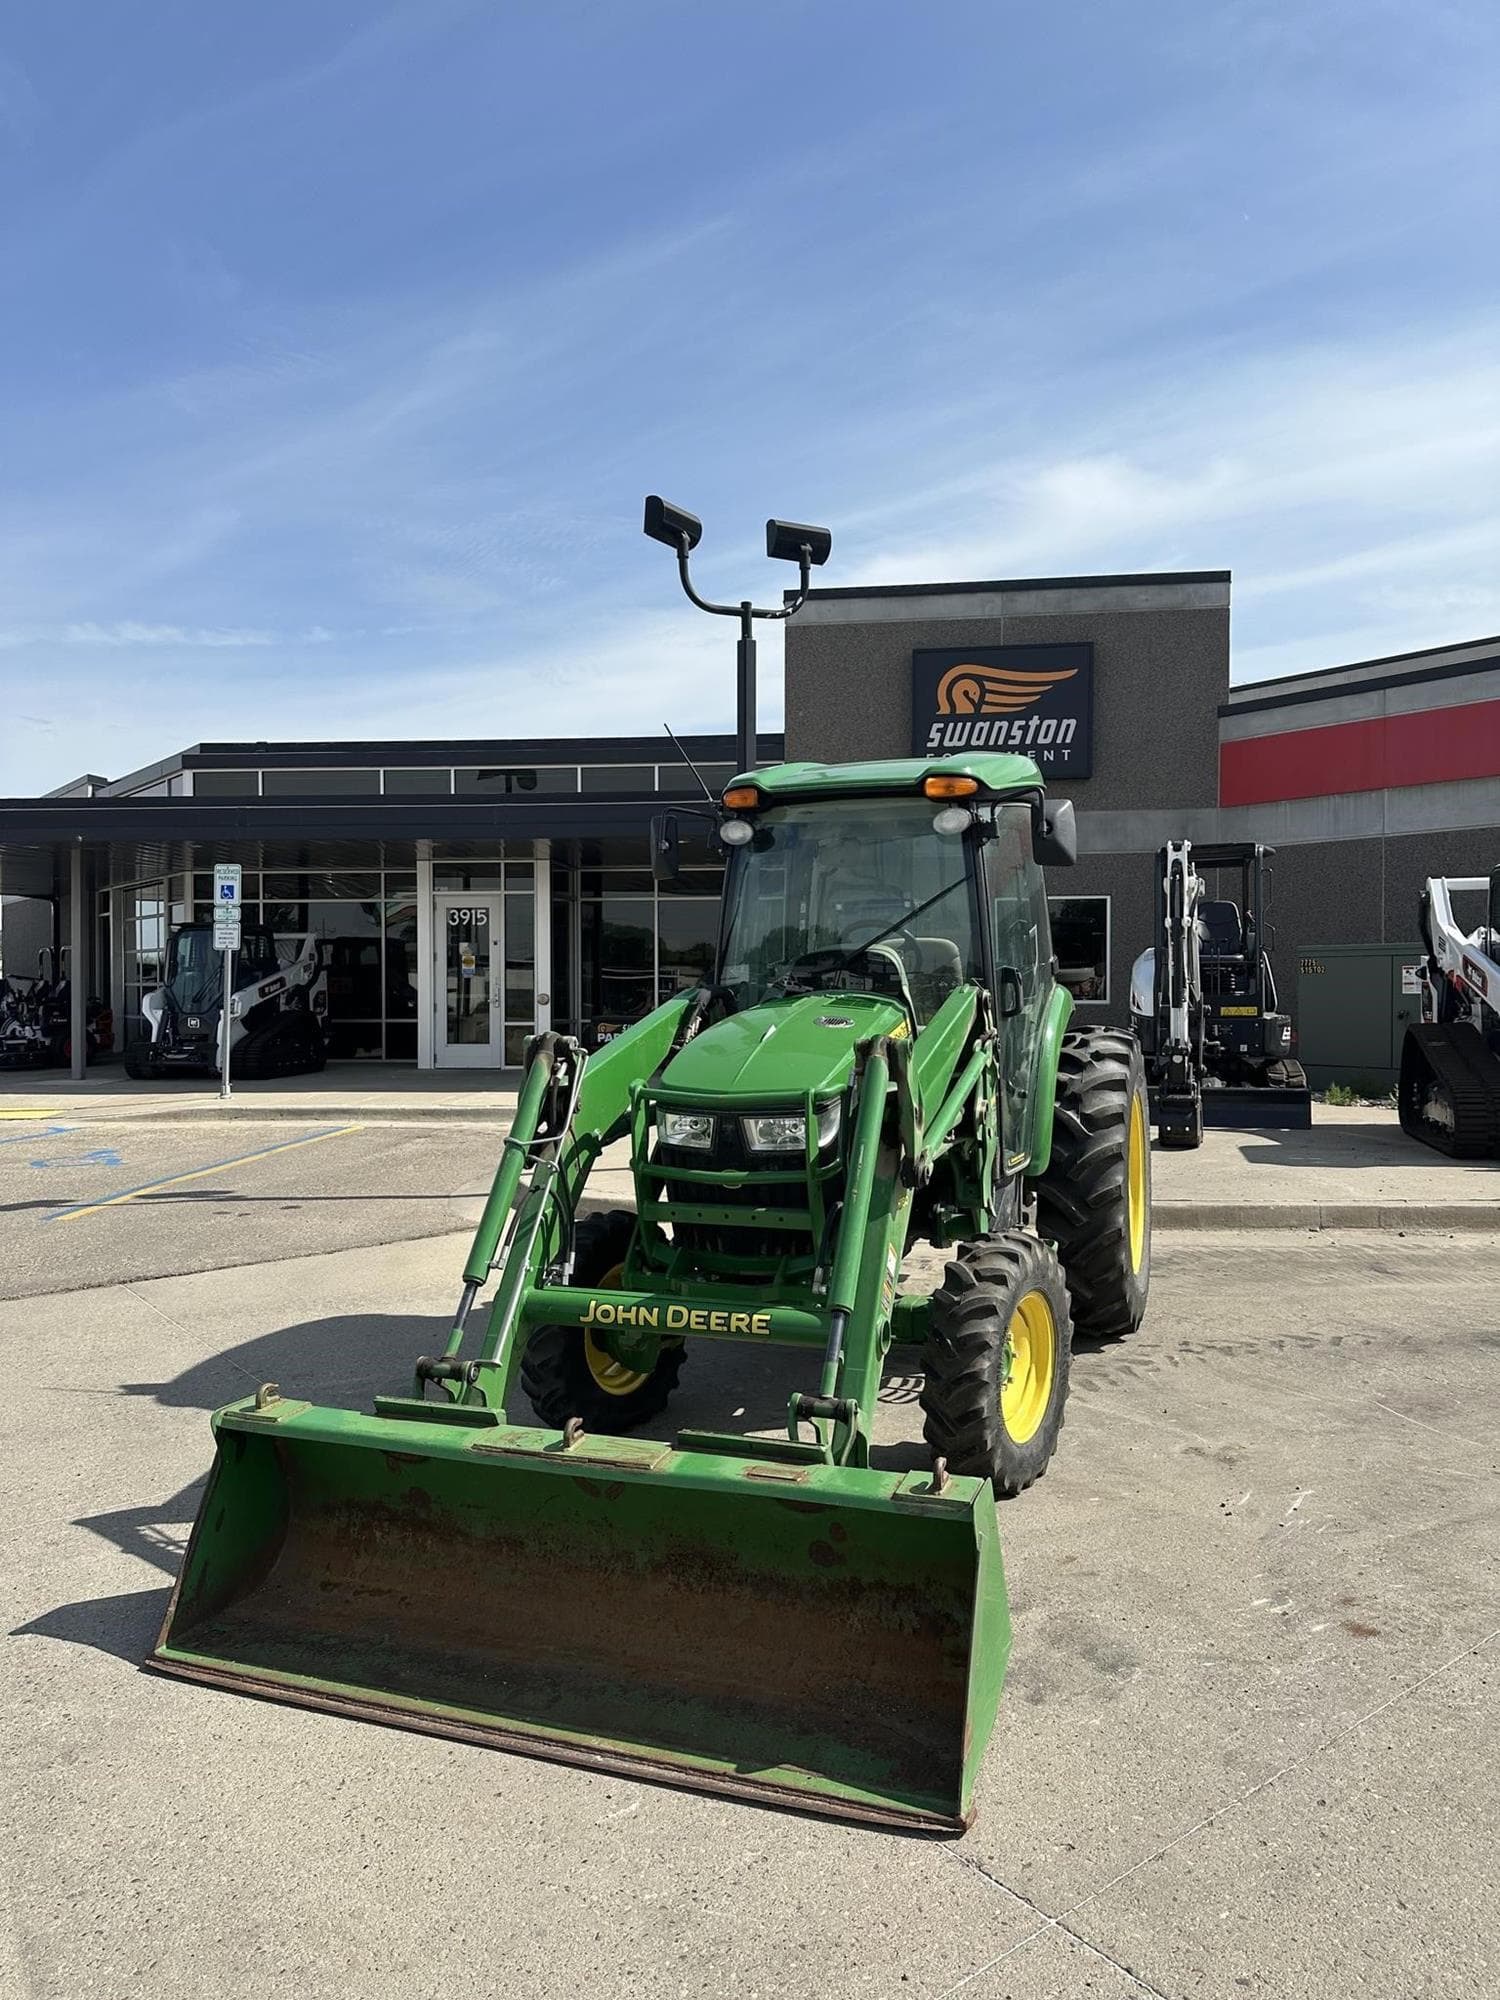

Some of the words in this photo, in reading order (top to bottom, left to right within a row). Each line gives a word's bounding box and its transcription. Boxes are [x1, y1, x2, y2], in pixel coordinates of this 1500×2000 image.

[926, 715, 1077, 748] swanston
[448, 909, 488, 926] 3915
[579, 1300, 660, 1327] JOHN
[666, 1305, 772, 1335] DEERE
